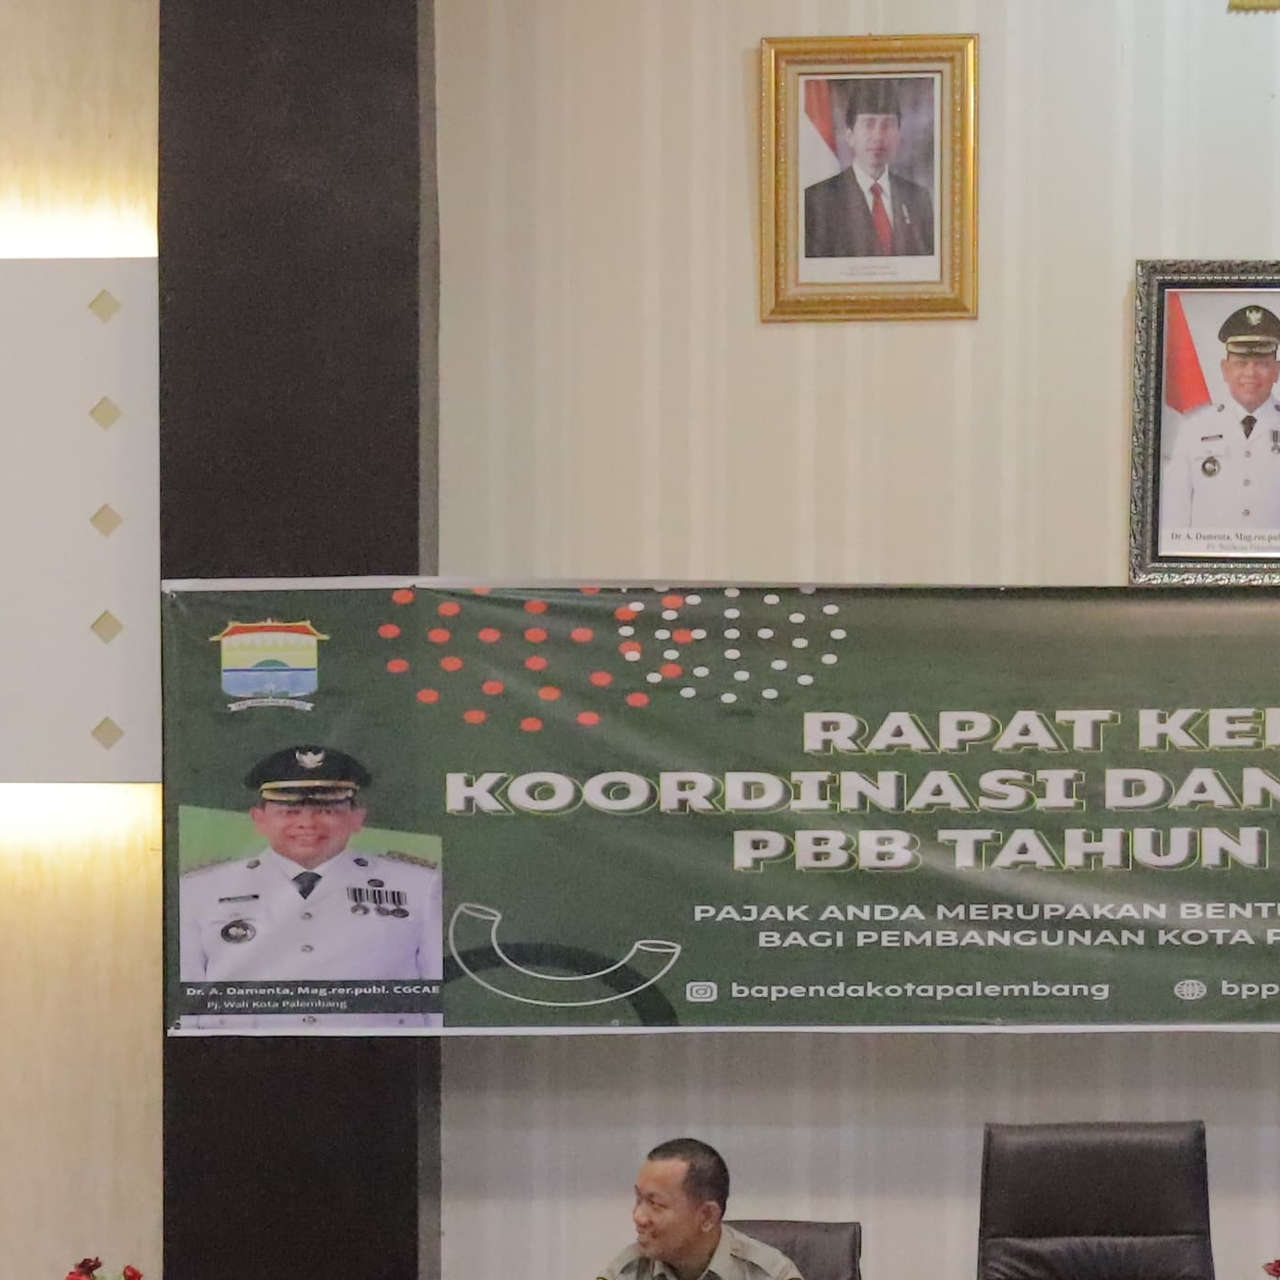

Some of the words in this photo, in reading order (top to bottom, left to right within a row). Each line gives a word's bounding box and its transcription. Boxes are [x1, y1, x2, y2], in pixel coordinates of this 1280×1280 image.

[802, 709, 1119, 754] RAPAT
[445, 768, 1086, 814] KOORDINASI
[733, 828, 921, 872] PBB
[937, 826, 1269, 871] TAHUN
[693, 904, 810, 921] PAJAK
[819, 904, 926, 921] ANDA
[936, 902, 1166, 920] MERUPAKAN
[759, 931, 844, 948] BAGI
[856, 929, 1146, 947] PEMBANGUNAN
[1158, 928, 1255, 946] KOTA
[186, 987, 205, 996] Dr.
[209, 987, 223, 996] A.
[226, 986, 293, 996] Damenta,
[393, 985, 440, 995] CGCAE
[731, 981, 1110, 1000] bapendakotapalembang
[252, 1001, 279, 1009] Kota
[282, 1000, 348, 1010] Palembang
